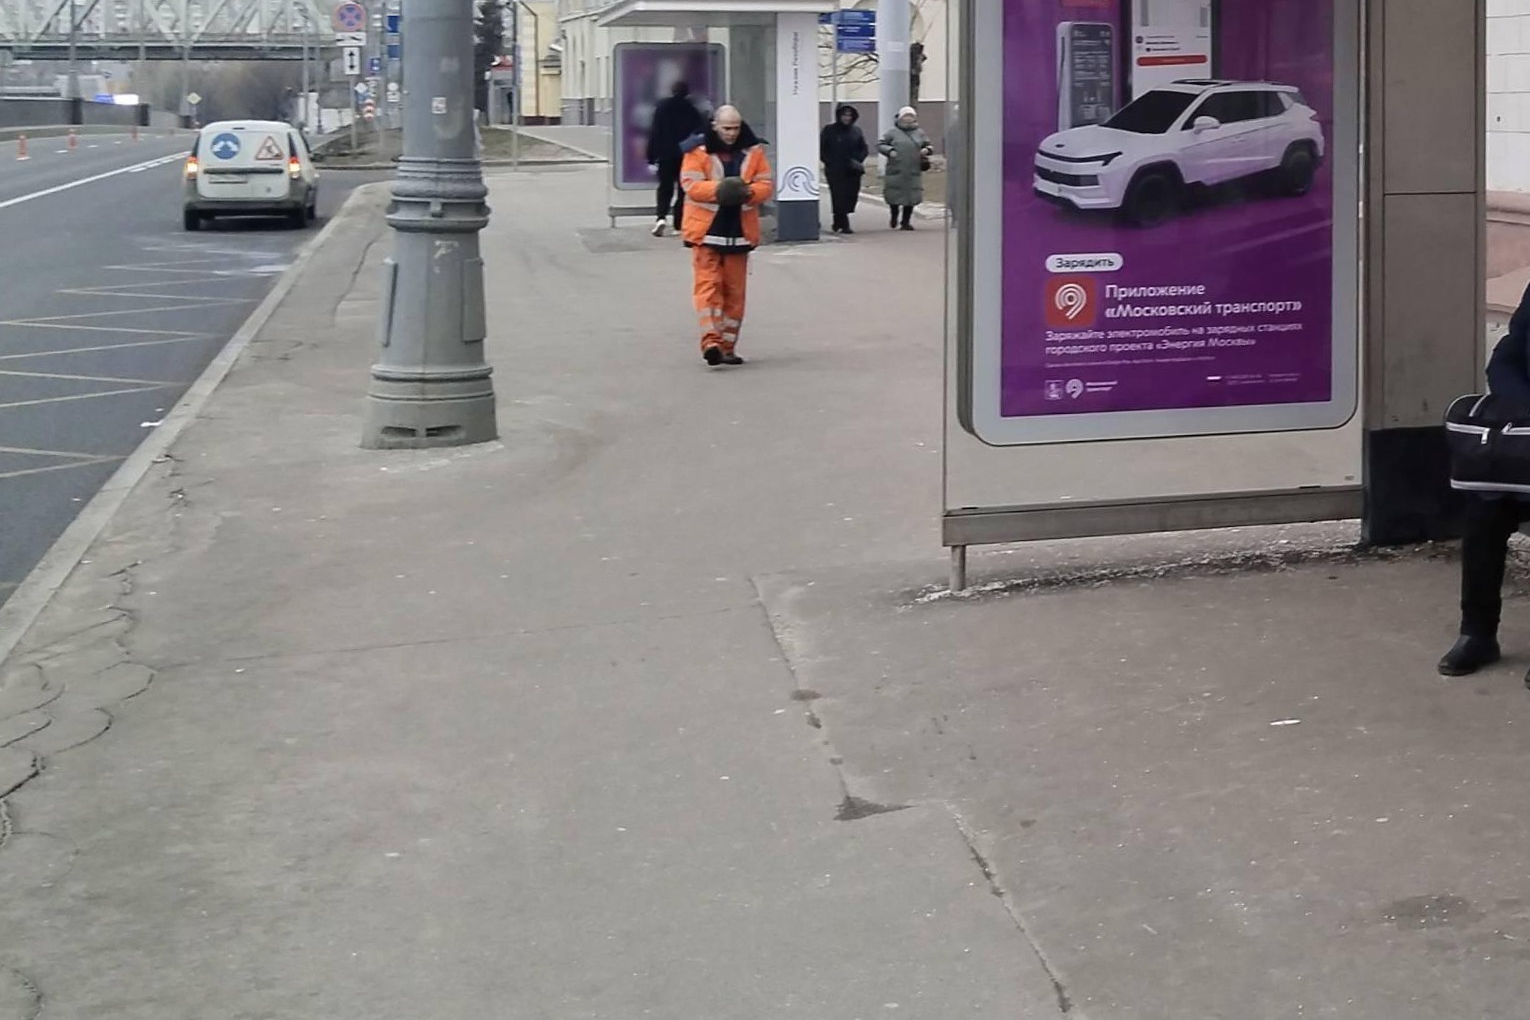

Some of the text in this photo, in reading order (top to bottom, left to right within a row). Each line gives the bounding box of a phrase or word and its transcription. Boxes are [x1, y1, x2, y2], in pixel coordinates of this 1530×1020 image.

[1056, 258, 1115, 270] Зарядить
[1105, 284, 1206, 301] Приложение
[1105, 301, 1302, 318] «Московский транспорт»
